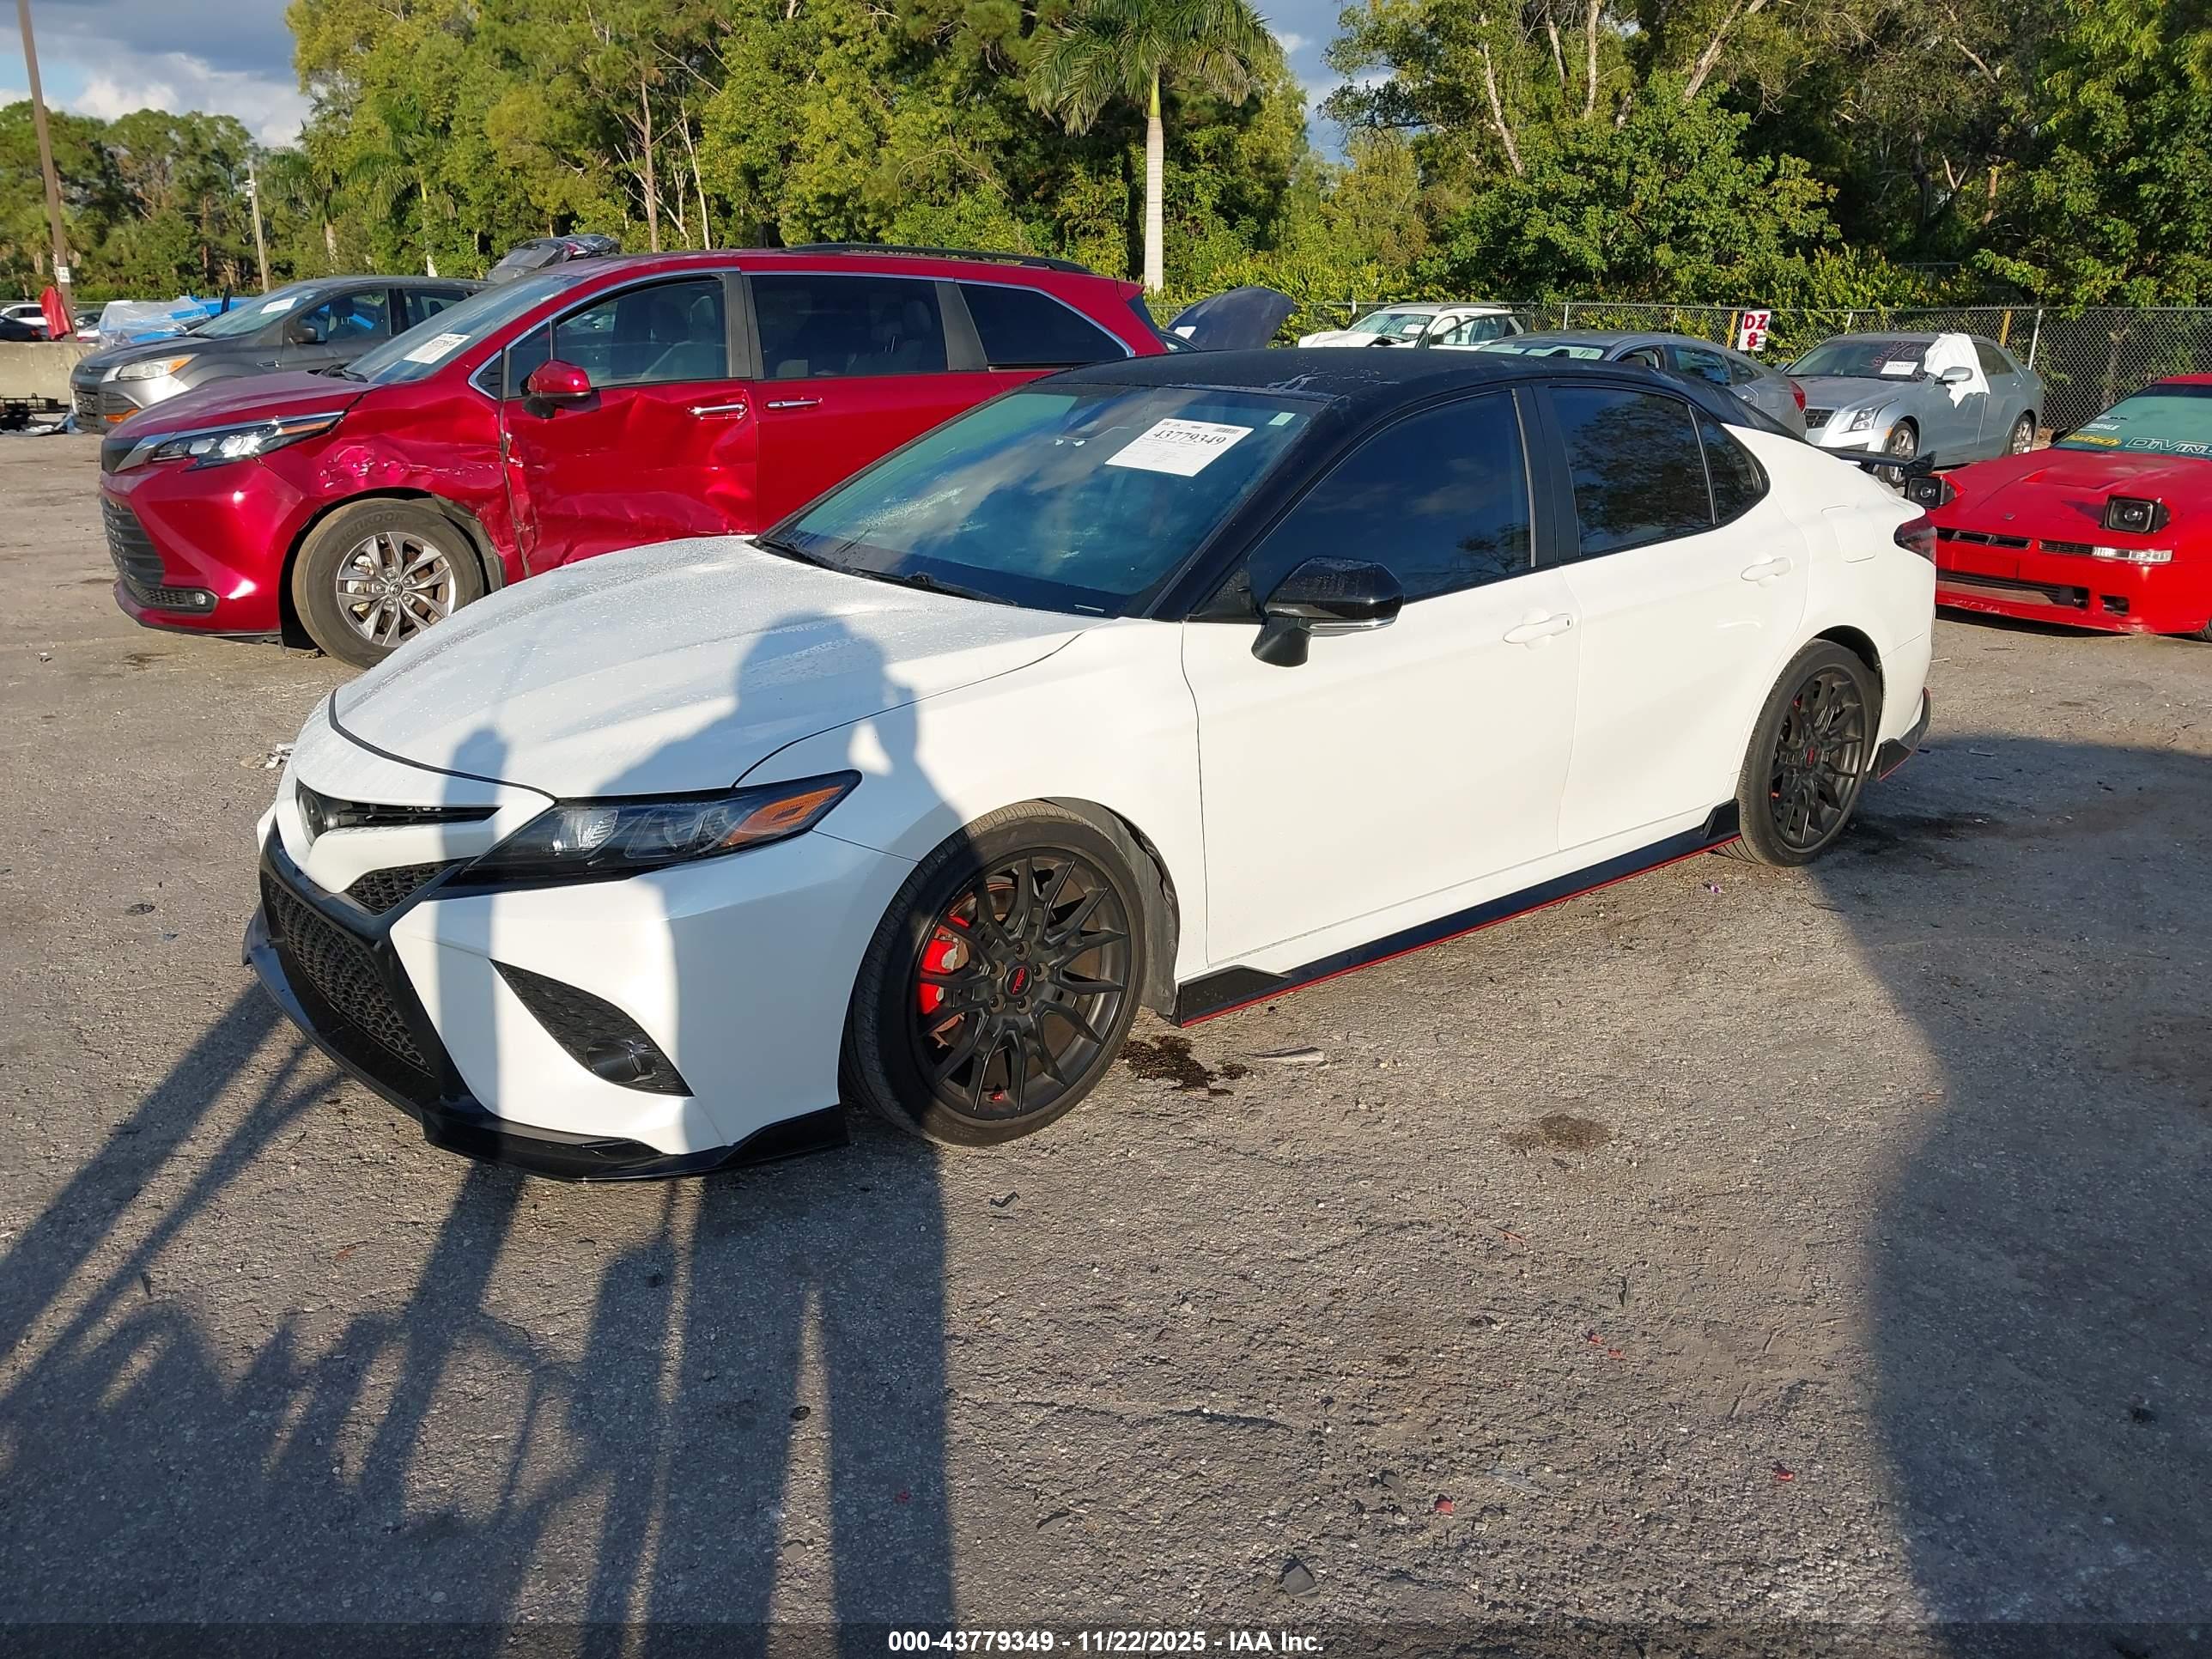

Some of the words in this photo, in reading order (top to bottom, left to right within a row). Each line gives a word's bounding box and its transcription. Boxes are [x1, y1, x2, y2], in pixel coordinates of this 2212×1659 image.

[1744, 314, 1769, 330] DZ
[1747, 332, 1758, 347] 8
[1153, 429, 1226, 446] 43779349
